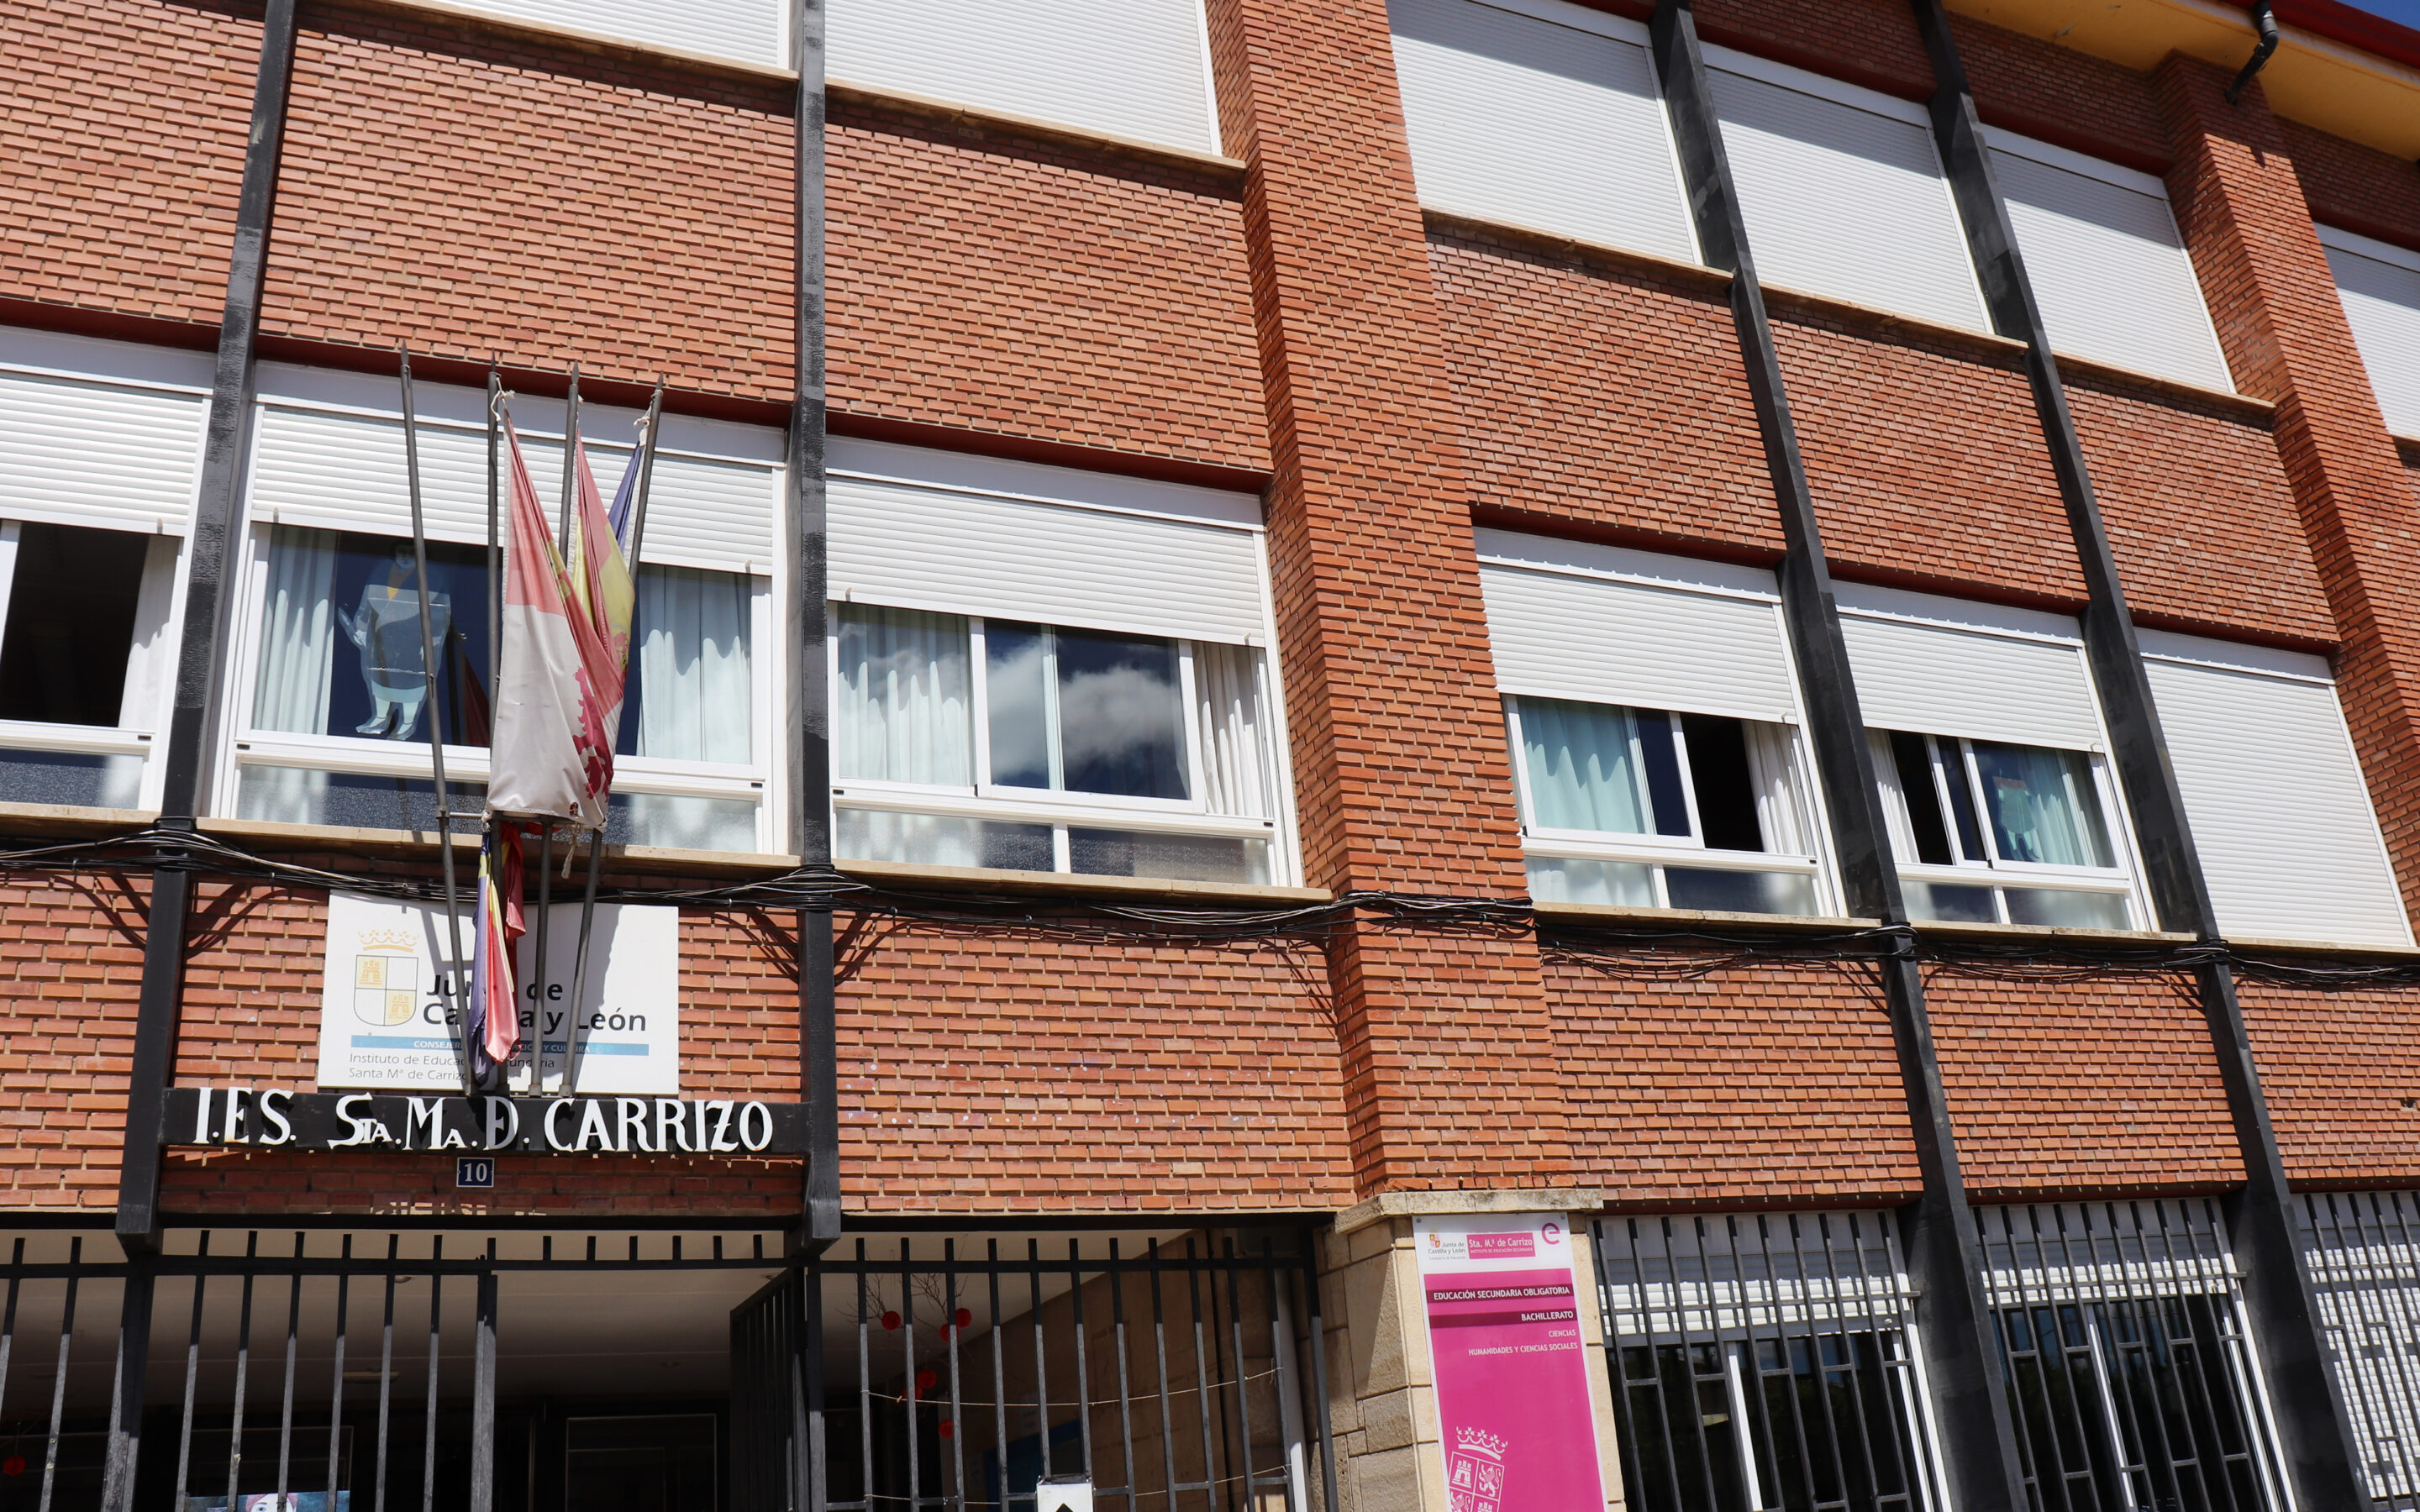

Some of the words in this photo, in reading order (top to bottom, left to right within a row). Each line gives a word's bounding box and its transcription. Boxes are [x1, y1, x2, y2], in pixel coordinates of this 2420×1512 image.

[544, 1011, 564, 1035] y
[413, 1040, 462, 1049] CONSEJER
[350, 1053, 400, 1064] Instituto
[403, 1054, 419, 1065] de
[350, 1068, 383, 1079] Santa
[408, 1068, 424, 1079] de
[544, 1097, 774, 1152] CARRIZO
[465, 1163, 487, 1183] 10
[1497, 1238, 1507, 1247] de
[1507, 1237, 1533, 1247] Carrizo
[1434, 1289, 1476, 1300] EDUCACIÓN
[1476, 1288, 1522, 1299] SECUNDARIA
[1523, 1286, 1570, 1297] OBLIGATORIA
[1521, 1310, 1574, 1321] BACHILLERATO
[1548, 1329, 1576, 1338] CIENCIAS
[1468, 1346, 1513, 1356] HUMANIDADES
[1520, 1344, 1548, 1353] CIENCIAS
[1549, 1342, 1578, 1352] SOCIALES
